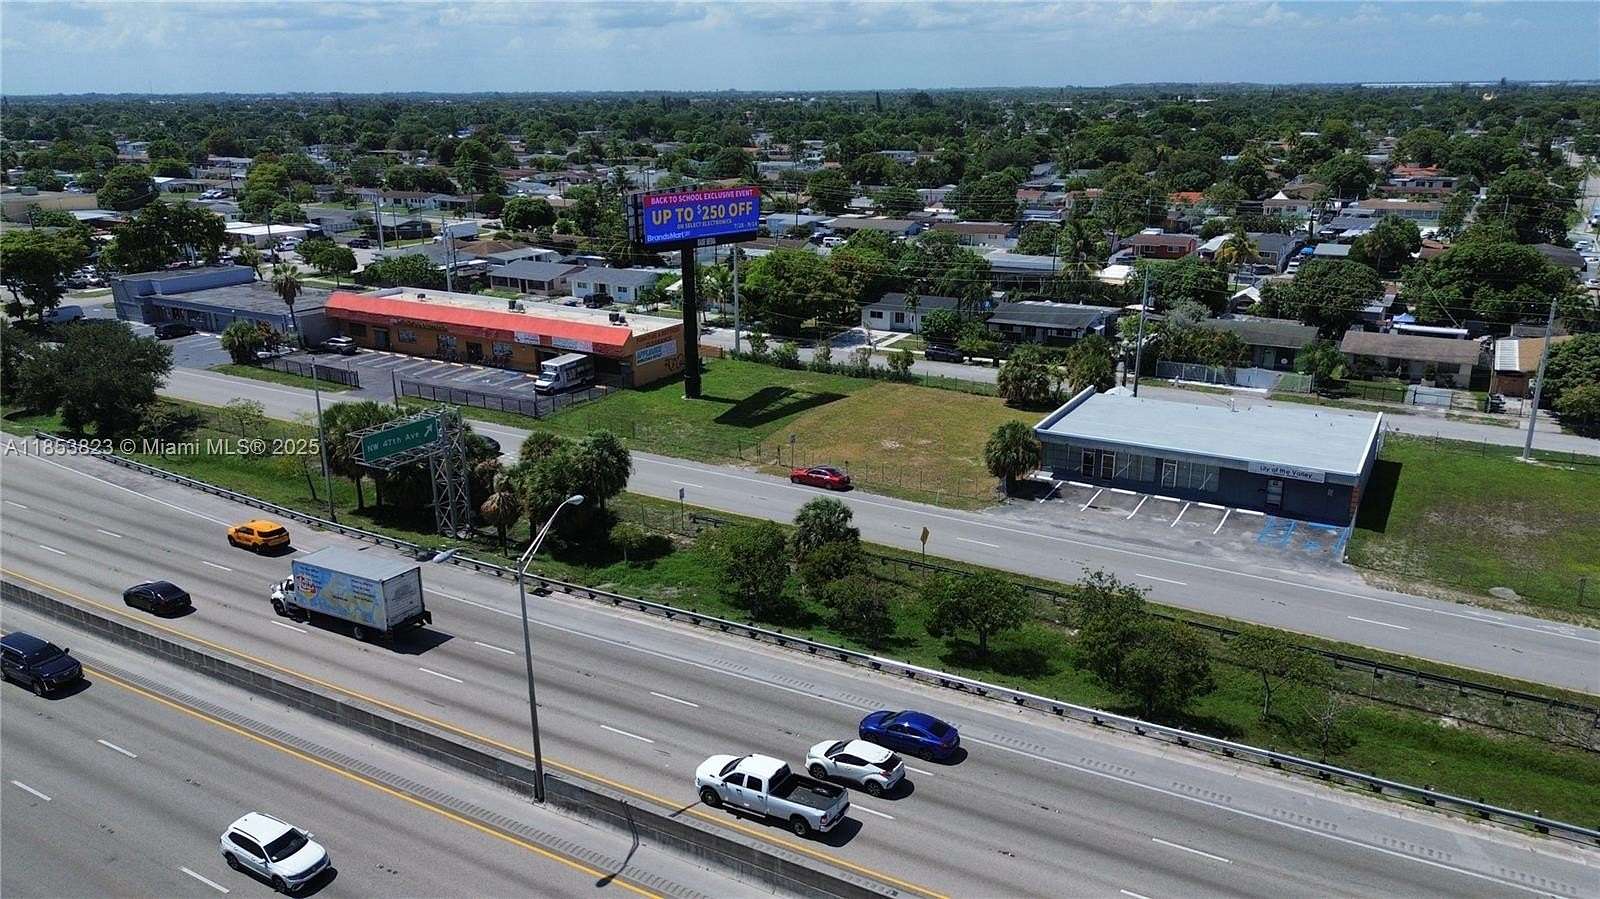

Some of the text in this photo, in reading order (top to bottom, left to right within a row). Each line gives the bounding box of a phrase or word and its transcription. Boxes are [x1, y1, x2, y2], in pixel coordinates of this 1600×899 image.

[651, 189, 753, 205] BACK TO SCHOOL EXCLUSIVE EVENT
[652, 202, 753, 225] UP TO $250 OFF
[367, 444, 380, 453] NW
